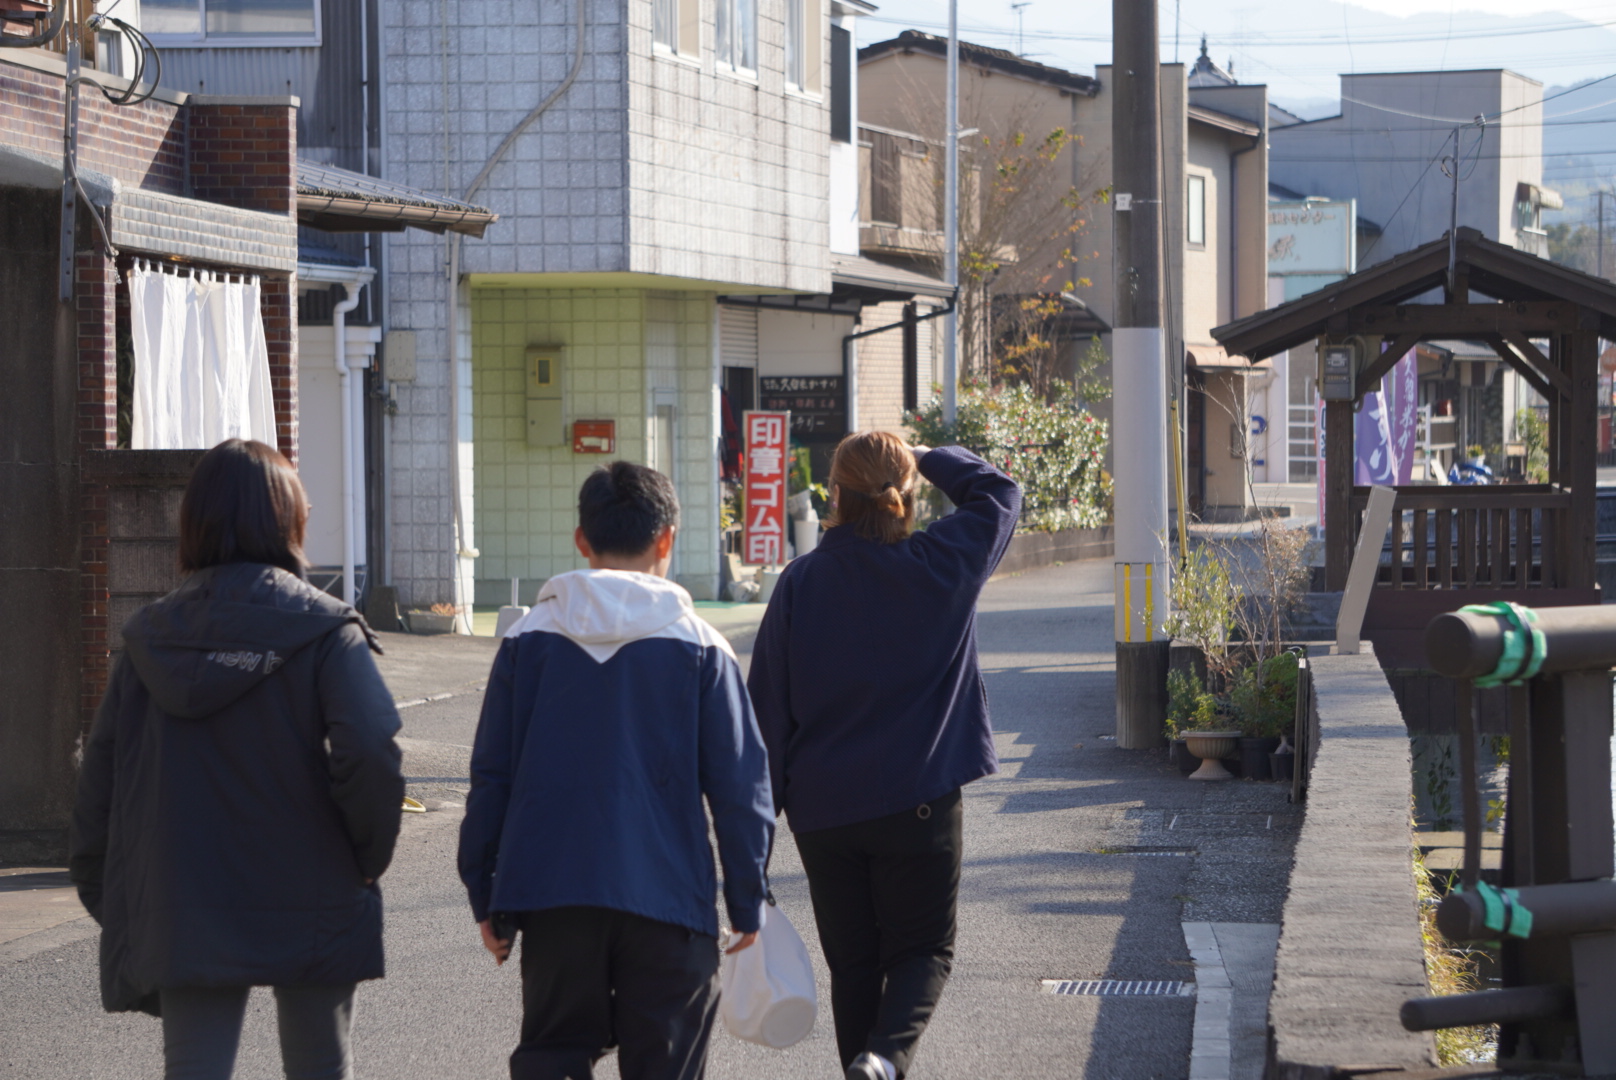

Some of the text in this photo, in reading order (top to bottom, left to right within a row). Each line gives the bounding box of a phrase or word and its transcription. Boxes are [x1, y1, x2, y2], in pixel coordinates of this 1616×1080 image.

[749, 416, 783, 564] 印章ゴム印
